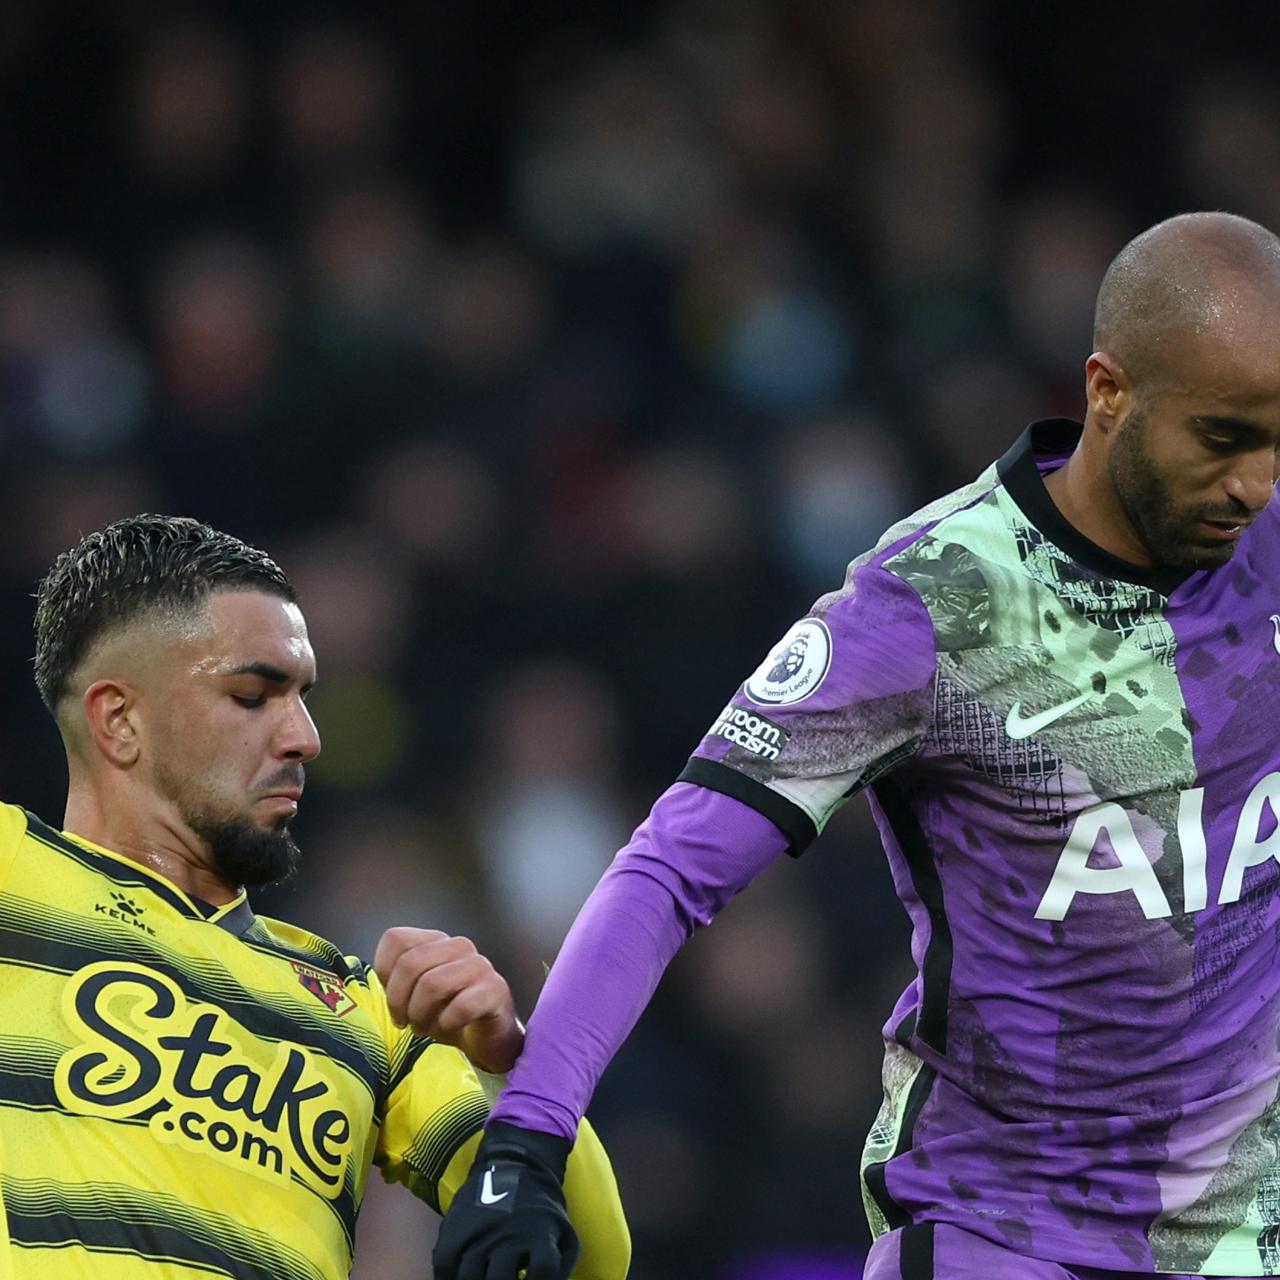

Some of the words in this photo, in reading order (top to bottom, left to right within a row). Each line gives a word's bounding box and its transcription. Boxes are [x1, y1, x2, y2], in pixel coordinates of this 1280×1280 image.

[789, 667, 814, 693] League
[717, 722, 780, 761] racism
[728, 709, 780, 744] room
[94, 904, 157, 937] KELME
[67, 968, 350, 1186] Stake
[163, 1116, 284, 1175] .com
